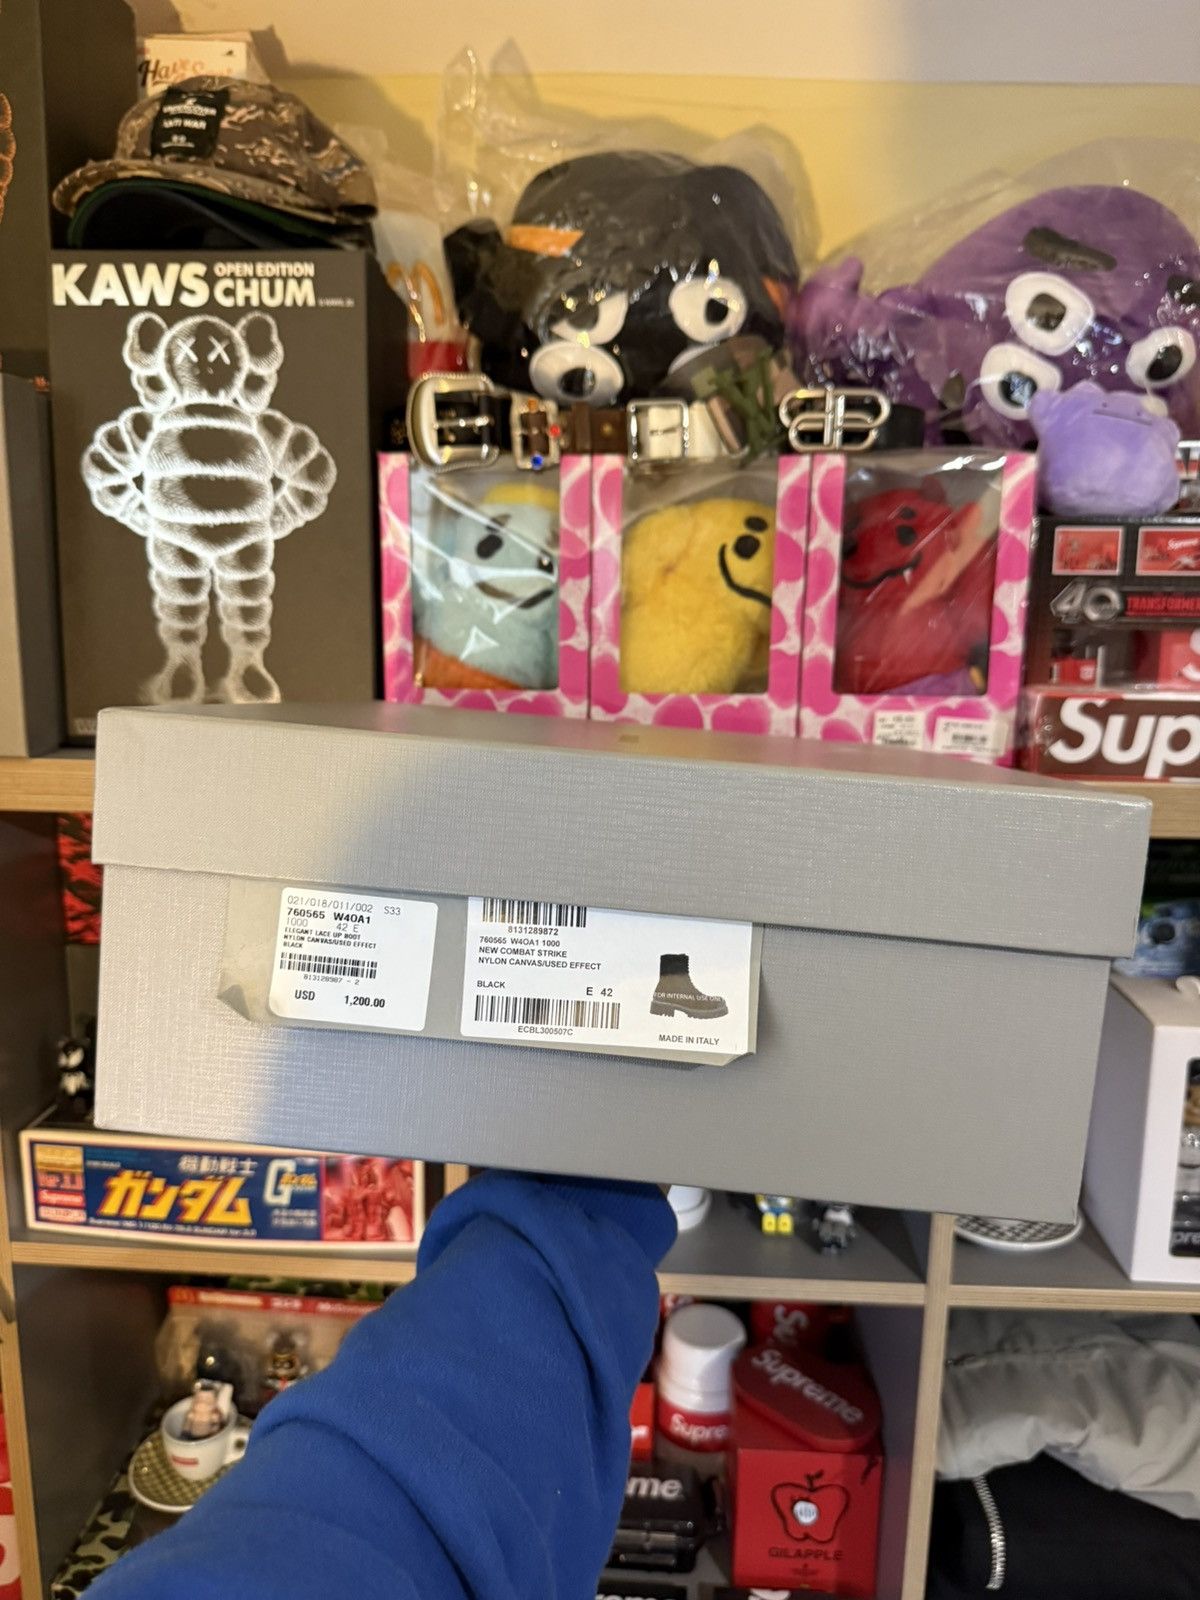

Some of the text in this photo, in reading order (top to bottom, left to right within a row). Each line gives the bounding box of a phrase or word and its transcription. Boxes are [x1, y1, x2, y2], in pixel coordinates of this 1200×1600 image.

[213, 261, 315, 279] OPEN EDITION
[51, 262, 211, 308] KAWS
[213, 278, 316, 308] CHUM
[287, 895, 401, 917] 021/018/011/002 S33
[287, 907, 325, 920] 760565
[286, 917, 359, 934] 1000 42 E
[507, 926, 560, 937] 8131289872
[315, 930, 331, 939] LACE
[332, 932, 343, 940] UP
[344, 933, 361, 942] BOOT
[479, 935, 507, 946] 760565
[542, 939, 561, 949] 1000
[282, 940, 304, 949] BLACK
[353, 941, 377, 950] EFFECT
[479, 946, 568, 959] NEW COMBAT STRIKE
[478, 956, 602, 971] NYLON CANVAS/USED EFFECT
[476, 980, 505, 989] BLACK
[294, 988, 386, 1009] USD 1,200.00
[586, 987, 613, 998] E 42
[517, 1026, 574, 1037] ECBL300507C
[658, 1034, 720, 1046] MADE IN ITALY
[97, 1169, 253, 1225] ガンダム
[752, 1348, 863, 1424] Supreme
